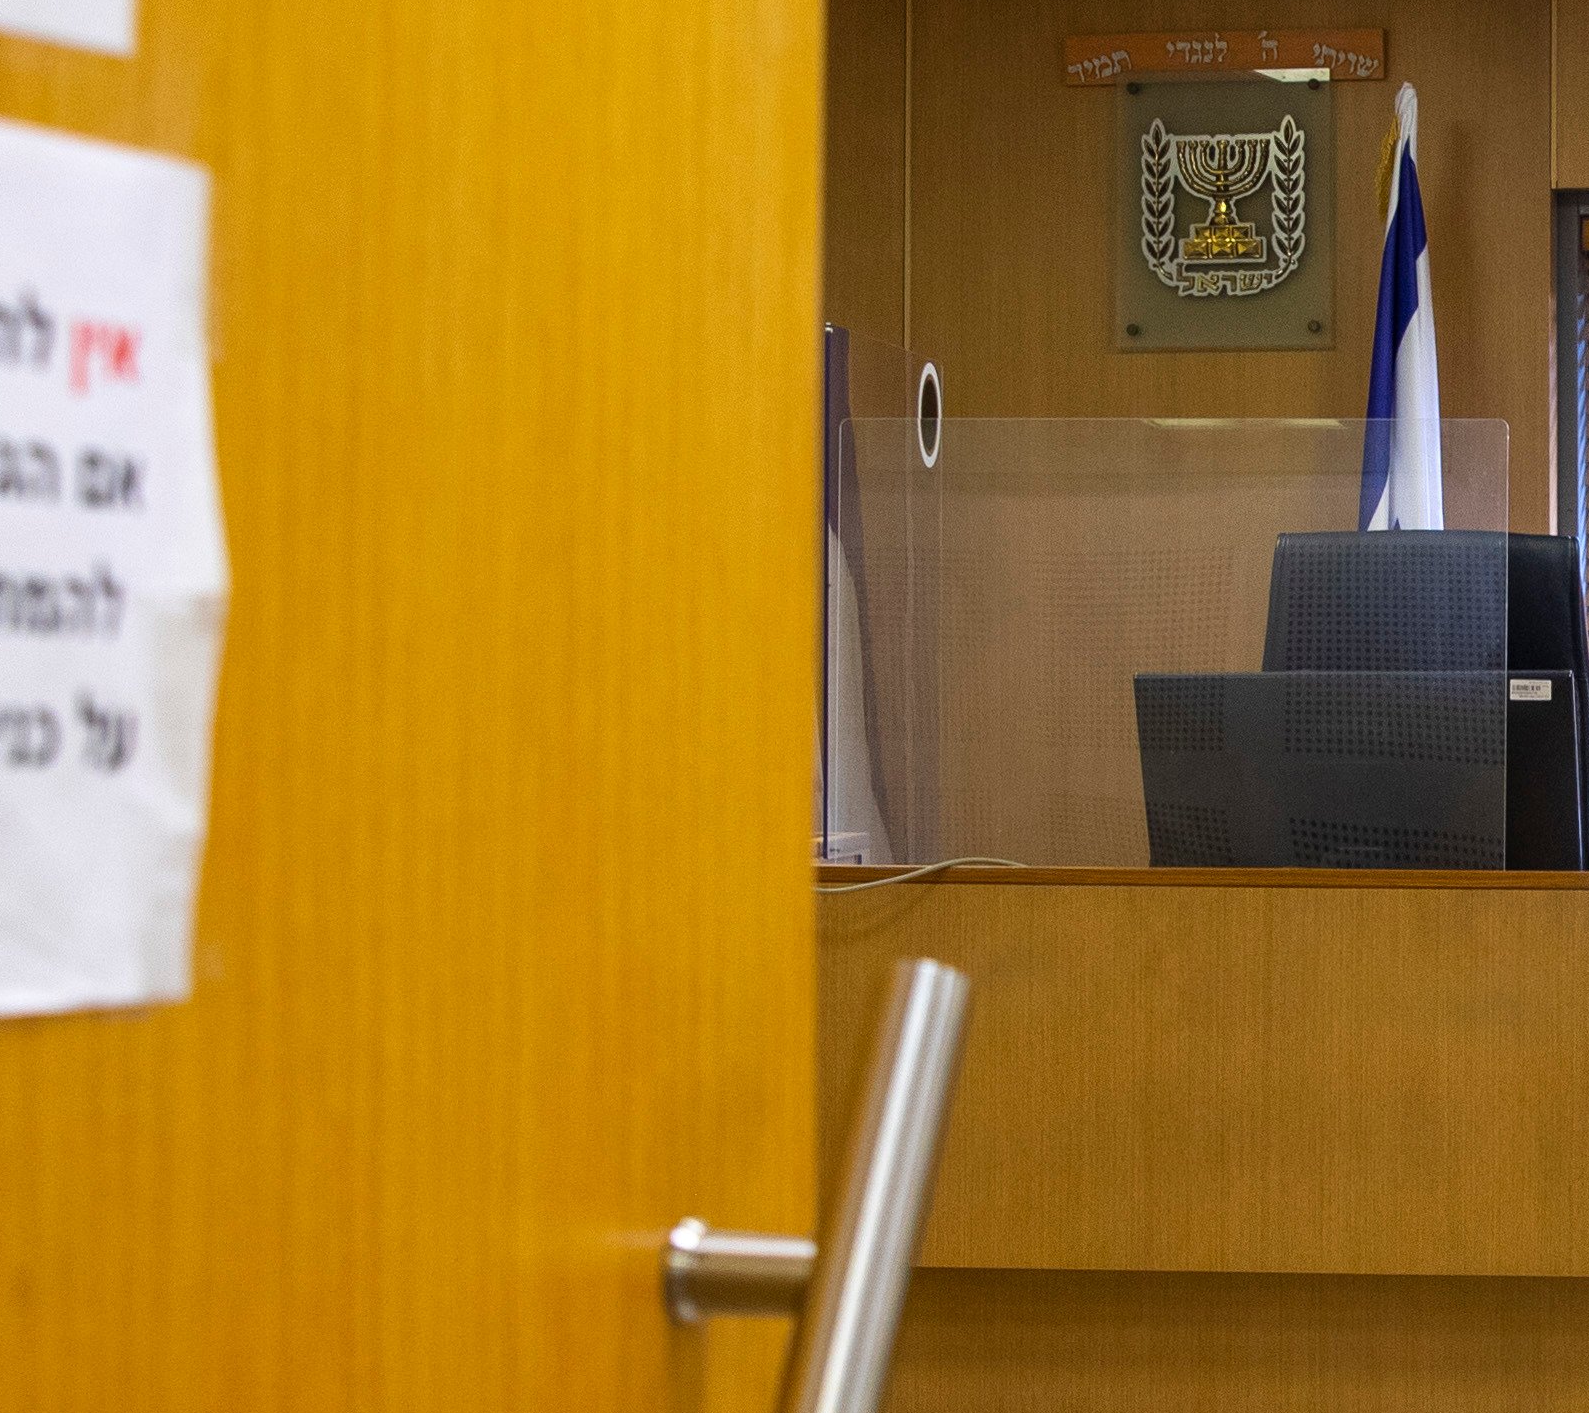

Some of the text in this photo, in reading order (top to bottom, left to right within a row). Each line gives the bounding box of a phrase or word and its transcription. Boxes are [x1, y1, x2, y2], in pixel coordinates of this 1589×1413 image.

[1165, 32, 1229, 64] לנגדי
[1312, 42, 1381, 77] שויתי
[1066, 49, 1133, 83] תמיד
[1175, 261, 1275, 293] ישראל
[67, 318, 136, 397] אין
[77, 440, 143, 511] אם
[75, 691, 138, 774] על
